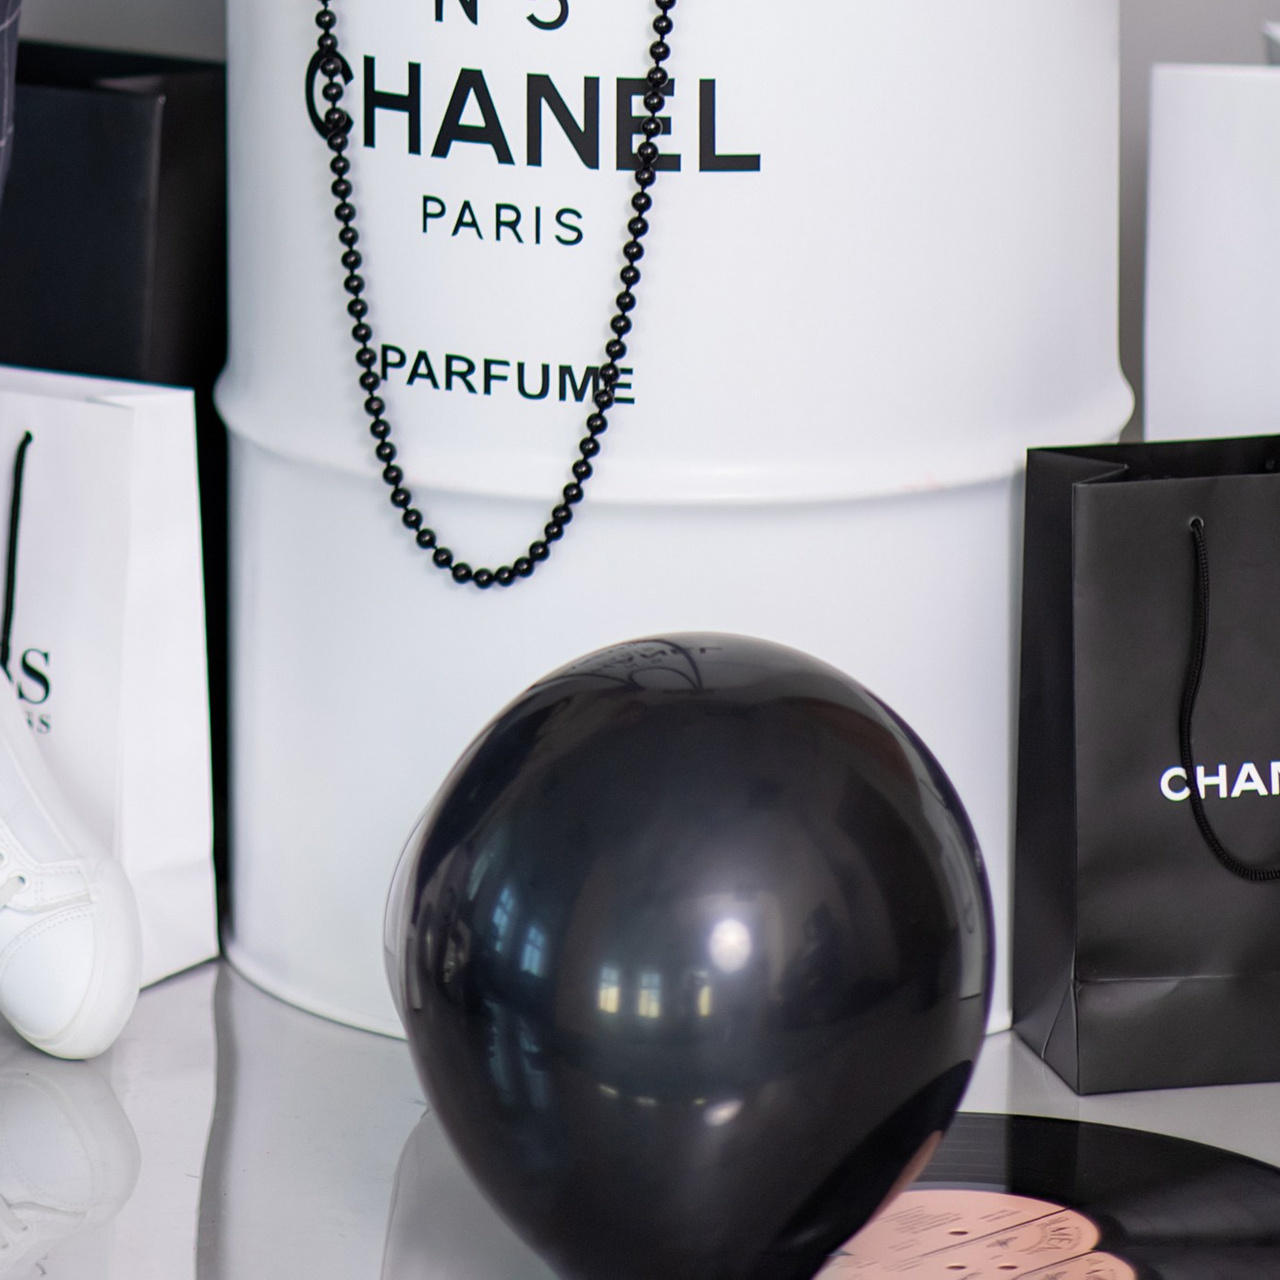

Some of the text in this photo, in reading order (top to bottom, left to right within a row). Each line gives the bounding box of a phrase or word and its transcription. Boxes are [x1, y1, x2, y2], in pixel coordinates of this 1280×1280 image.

[305, 49, 761, 172] CHANEL
[422, 195, 584, 246] PARIS
[380, 344, 635, 405] PARFUME
